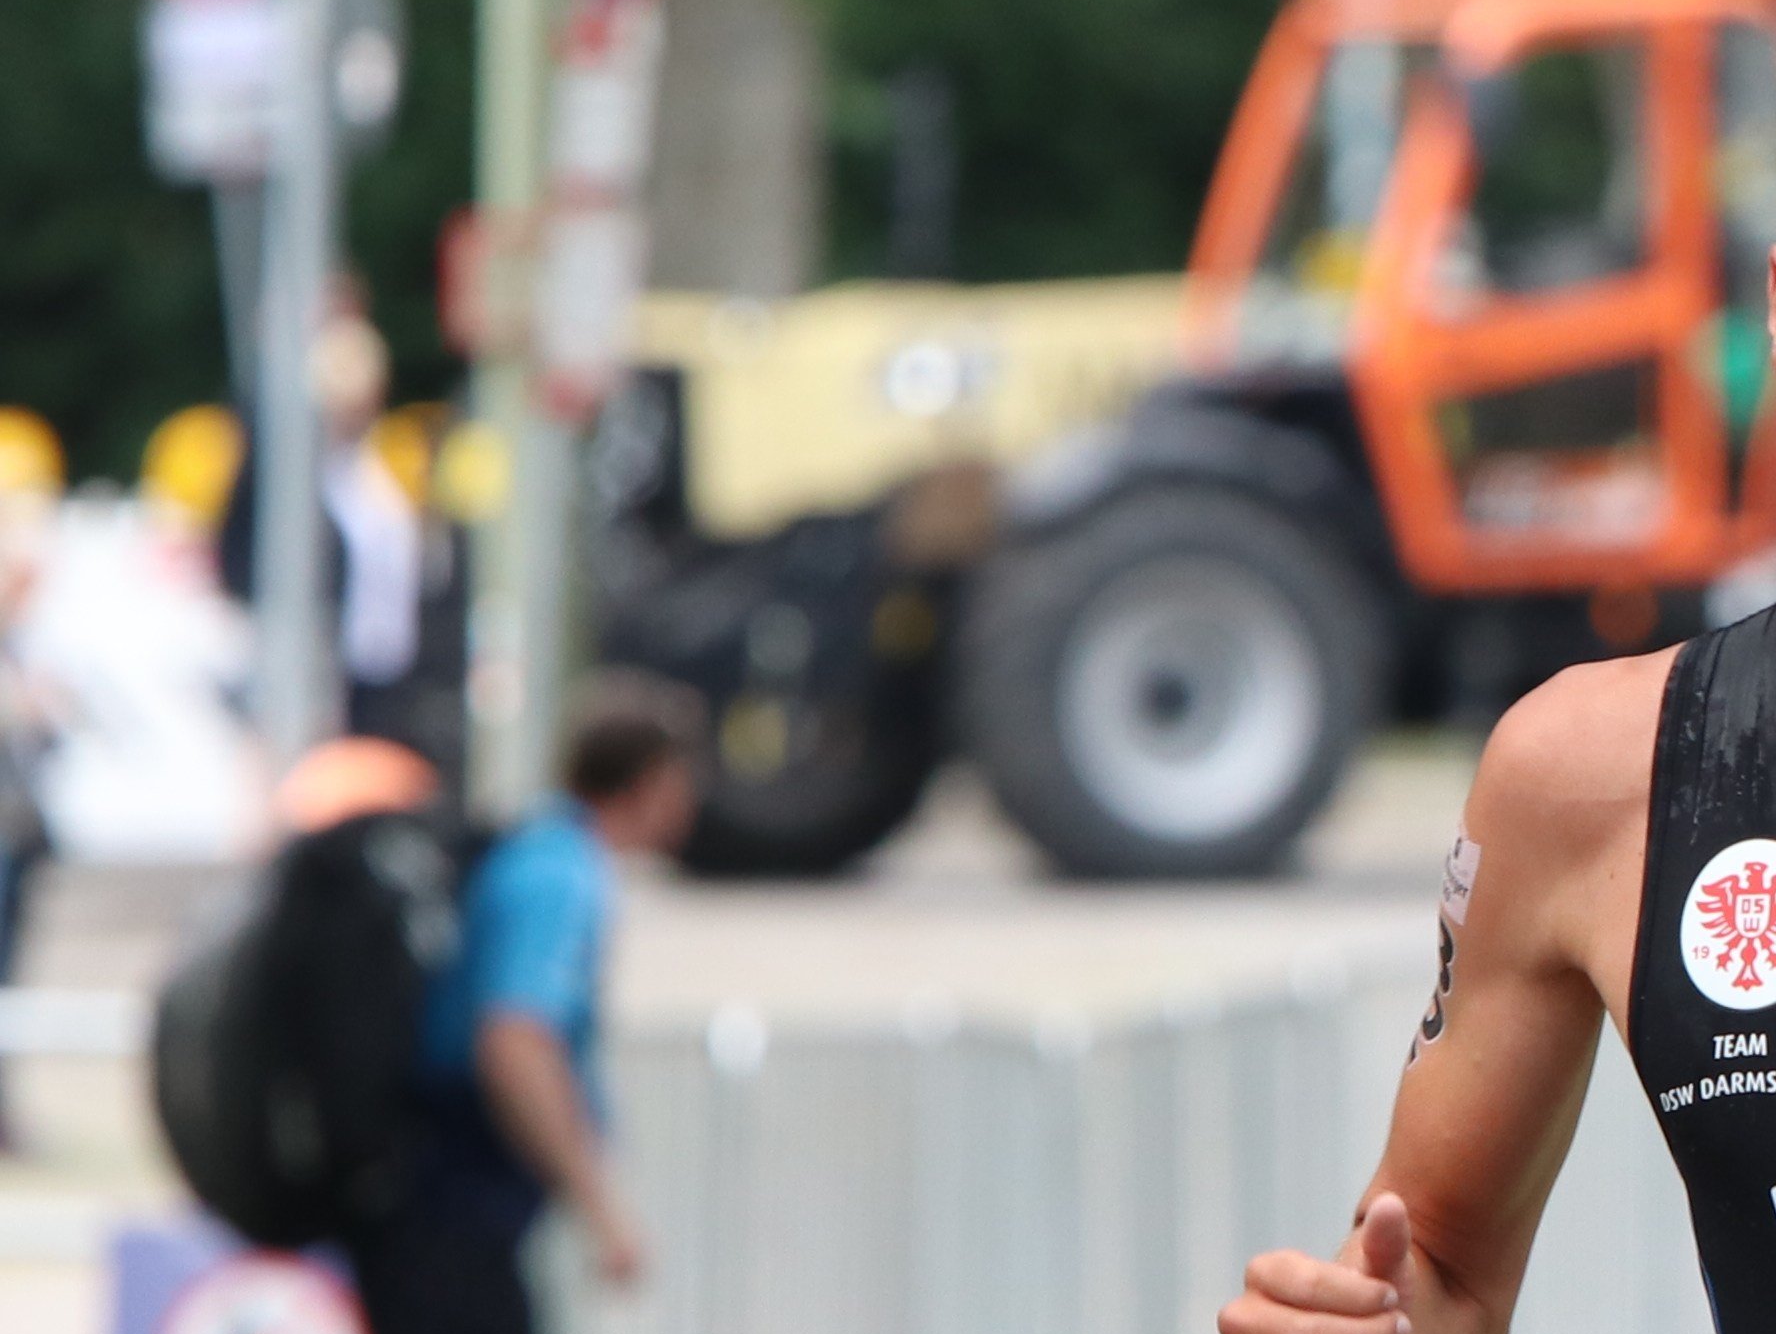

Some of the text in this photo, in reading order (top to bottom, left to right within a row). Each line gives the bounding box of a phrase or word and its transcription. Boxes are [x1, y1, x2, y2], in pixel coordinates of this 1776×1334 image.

[1692, 945, 1711, 960] 19
[1712, 1033, 1768, 1059] TEAM
[1659, 1083, 1694, 1112] DSW
